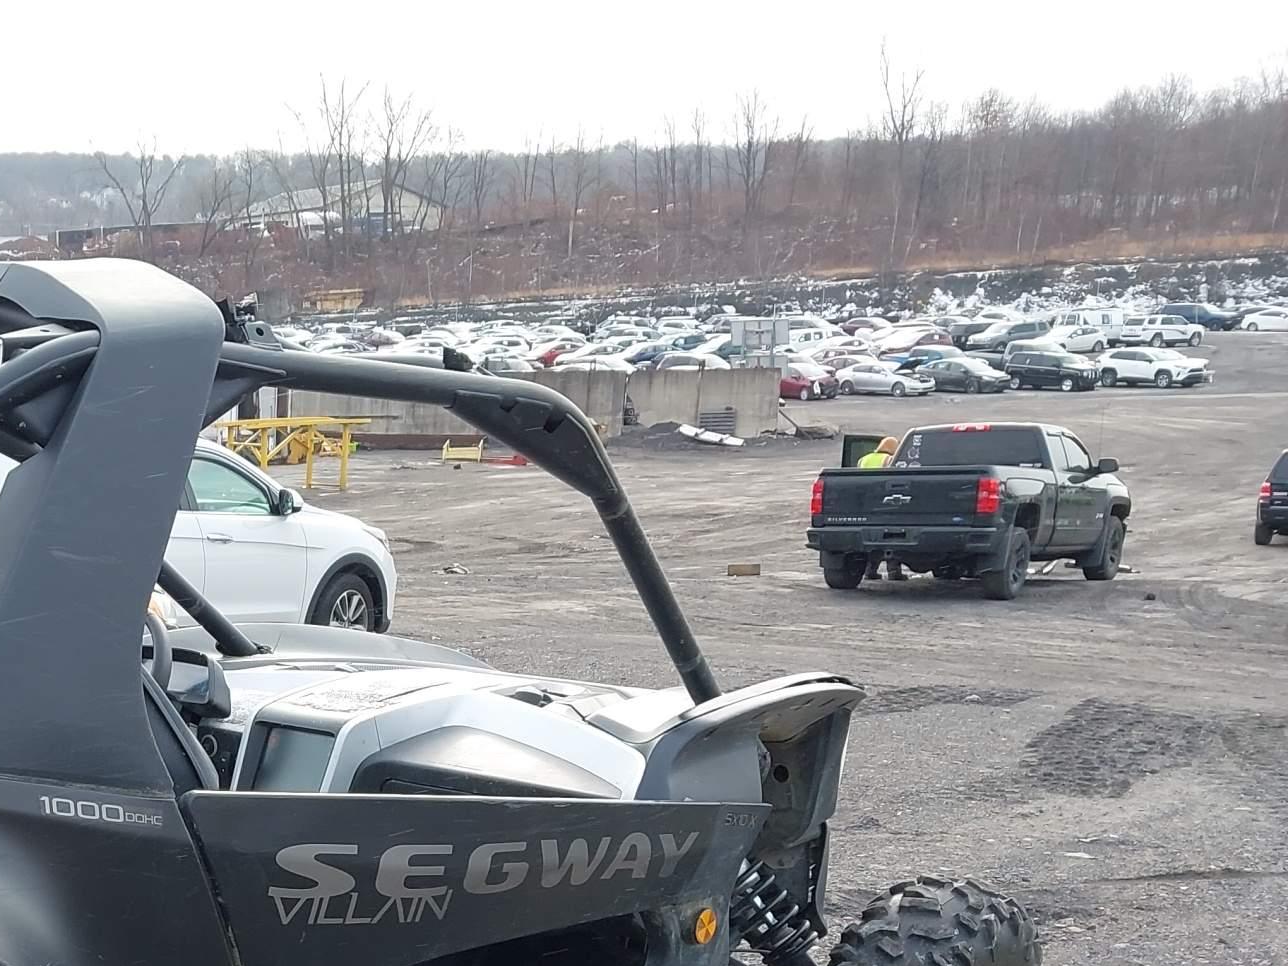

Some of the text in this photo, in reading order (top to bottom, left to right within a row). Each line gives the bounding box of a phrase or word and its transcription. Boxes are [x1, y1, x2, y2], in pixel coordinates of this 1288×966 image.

[40, 796, 163, 826] 1000 DOHC
[268, 831, 700, 898] SEGWAY
